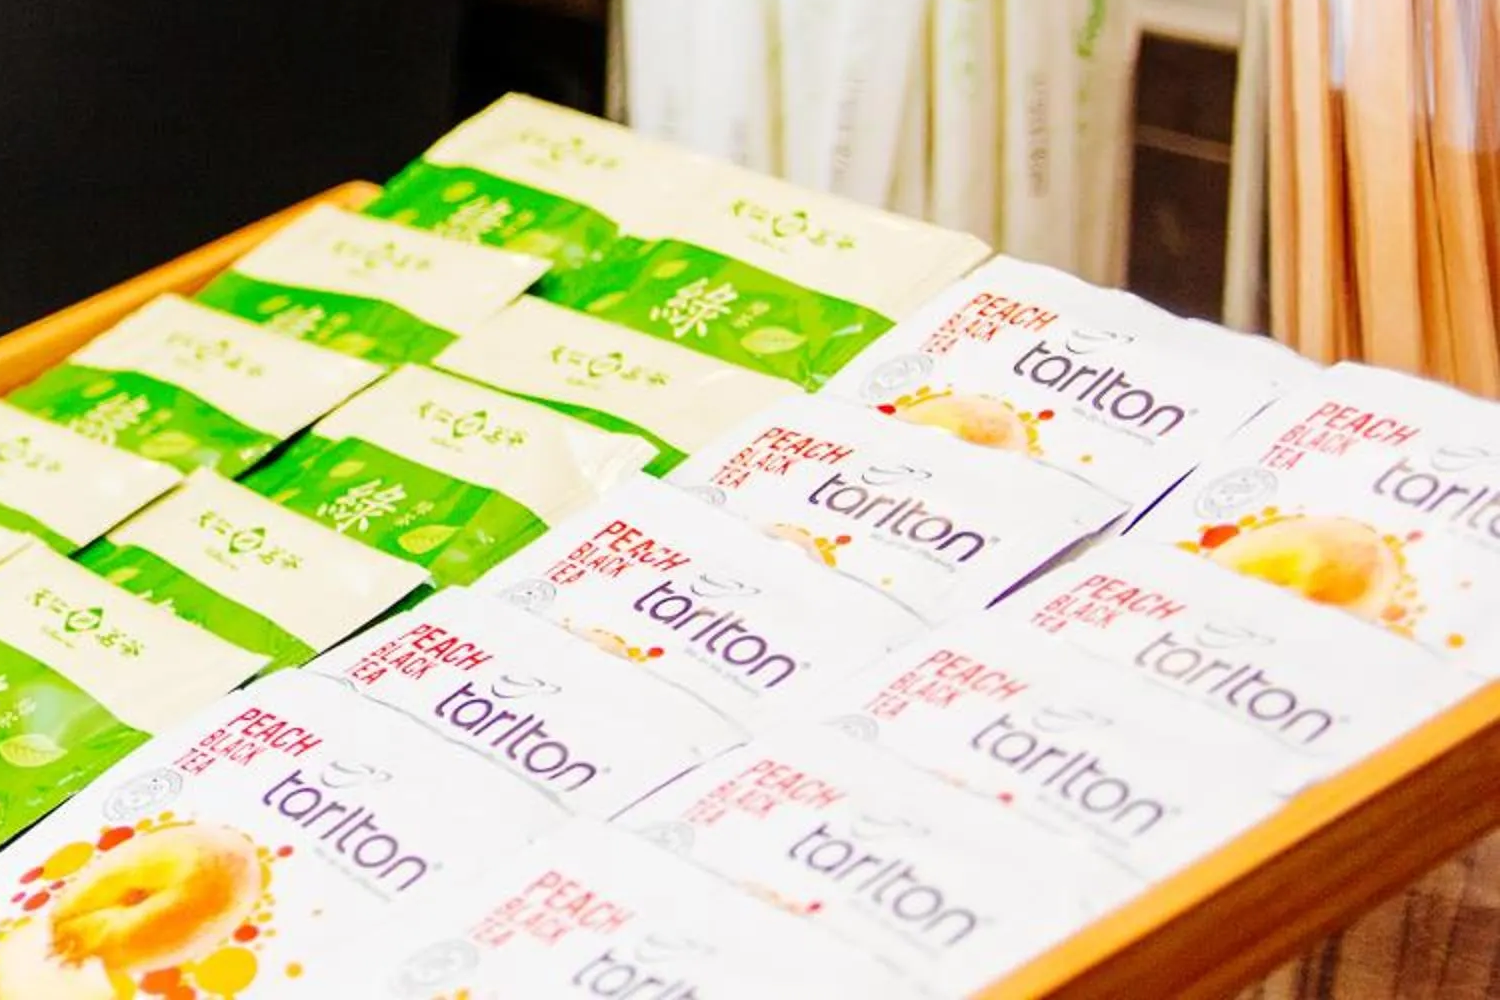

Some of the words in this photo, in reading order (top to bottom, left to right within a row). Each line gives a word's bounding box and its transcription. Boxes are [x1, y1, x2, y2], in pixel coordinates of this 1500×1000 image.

[968, 292, 1060, 333] PEACH
[1012, 339, 1187, 437] tarlton
[755, 425, 853, 465] PEACH
[1279, 425, 1359, 457] BLACK
[1306, 402, 1421, 446] PEACH
[1259, 446, 1305, 471] TEA
[808, 473, 986, 562] tarlton
[1373, 455, 1500, 540] tarlt
[566, 541, 639, 578] BLACK
[591, 519, 691, 572] PEACH
[1042, 593, 1119, 628] BLACK
[1071, 574, 1186, 620] PEACH
[397, 622, 494, 670] PEACH
[632, 580, 796, 689] tarlton
[345, 659, 390, 686] TEA
[370, 642, 441, 681] BLACK
[917, 649, 1030, 699] PEACH
[1134, 631, 1333, 744] tarlton
[199, 727, 271, 767] BLACK
[228, 708, 323, 758] PEACH
[433, 681, 597, 792] tarlton
[736, 760, 848, 808] PEACH
[970, 712, 1167, 837] tarlton
[260, 767, 428, 891] tarlton
[786, 821, 978, 947] tarlton
